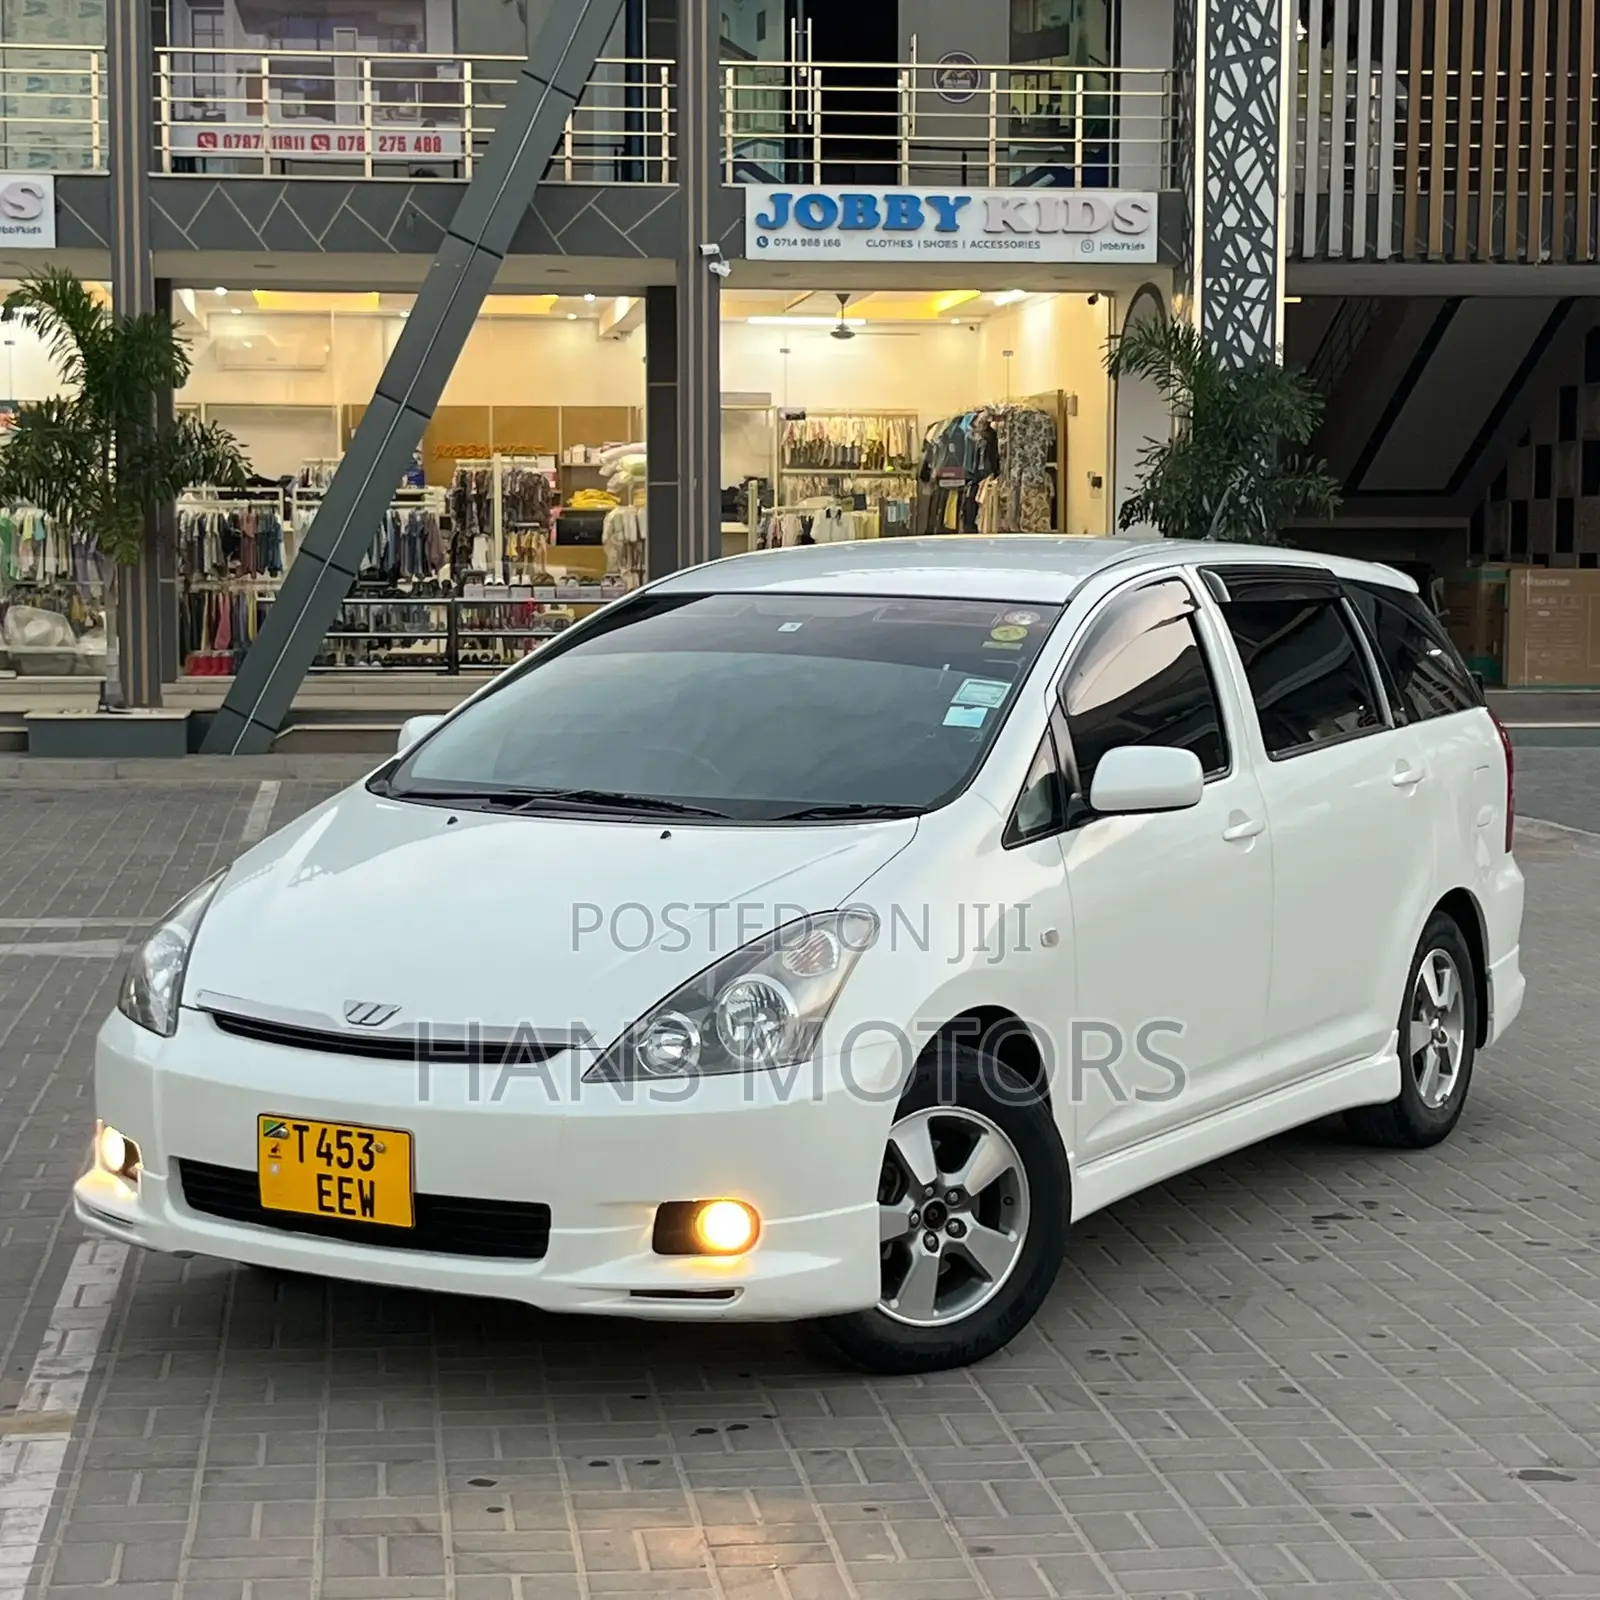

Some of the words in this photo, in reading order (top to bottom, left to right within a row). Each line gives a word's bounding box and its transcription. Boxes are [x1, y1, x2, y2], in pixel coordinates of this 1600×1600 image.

[378, 135, 407, 152] 275
[755, 193, 972, 232] JOBBY
[983, 196, 1153, 236] KIDS
[773, 237, 798, 248] 0714
[865, 239, 914, 249] CLOTHES
[923, 239, 959, 249] SHOES
[969, 240, 1041, 250] ACCESSORIES
[292, 1123, 310, 1164] T
[316, 1127, 376, 1172] 453
[316, 1172, 376, 1218] EEW
